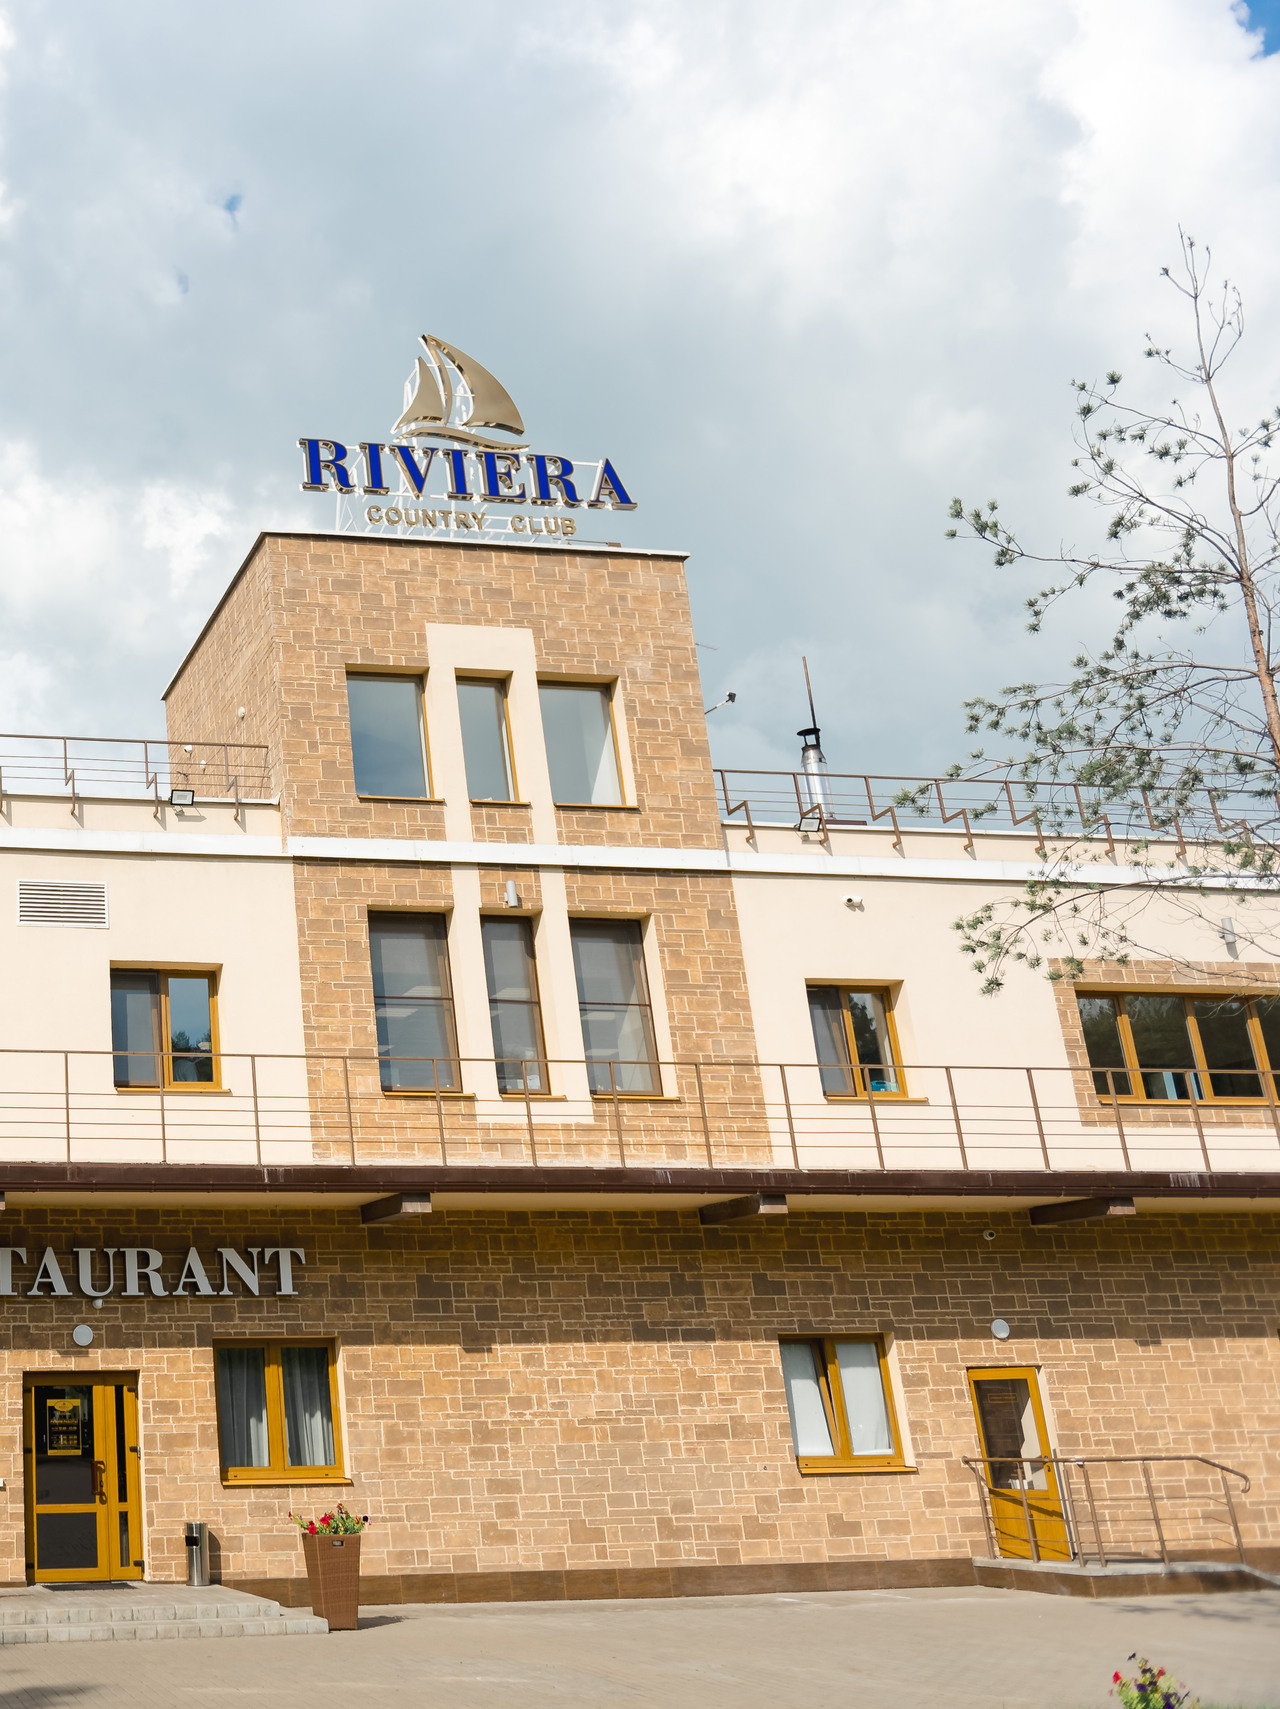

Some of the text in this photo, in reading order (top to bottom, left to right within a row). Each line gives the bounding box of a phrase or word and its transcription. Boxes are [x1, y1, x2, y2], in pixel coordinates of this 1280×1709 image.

[297, 437, 639, 510] RIVIERA
[366, 505, 577, 536] COUNTRY CLUB
